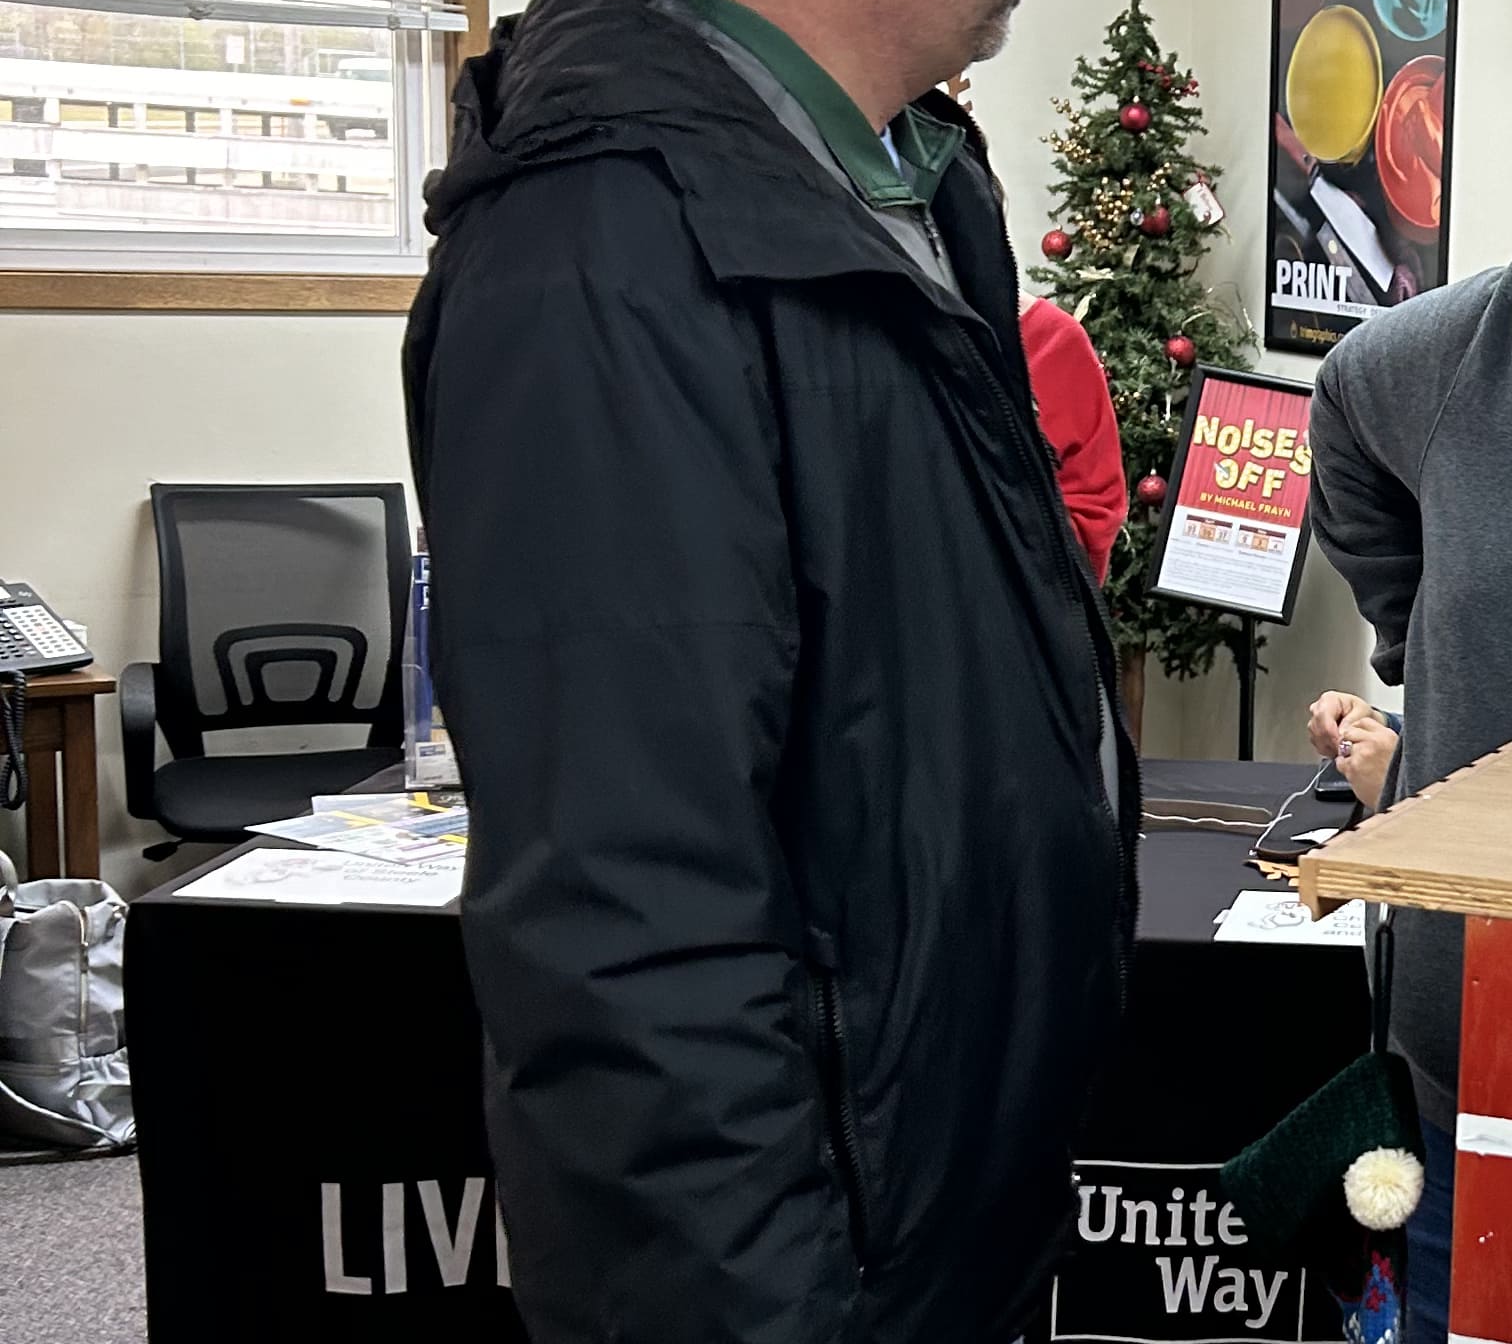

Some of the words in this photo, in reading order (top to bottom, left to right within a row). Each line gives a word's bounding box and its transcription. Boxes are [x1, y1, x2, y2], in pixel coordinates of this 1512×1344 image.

[1276, 259, 1352, 303] PRINT
[1193, 415, 1312, 476] NOISES
[1215, 458, 1286, 499] OFF
[1200, 492, 1213, 504] BY
[1215, 495, 1256, 512] MICHAEL
[1258, 503, 1293, 519] FRAYN
[1077, 1186, 1249, 1246] Unite
[1155, 1255, 1289, 1329] Way
